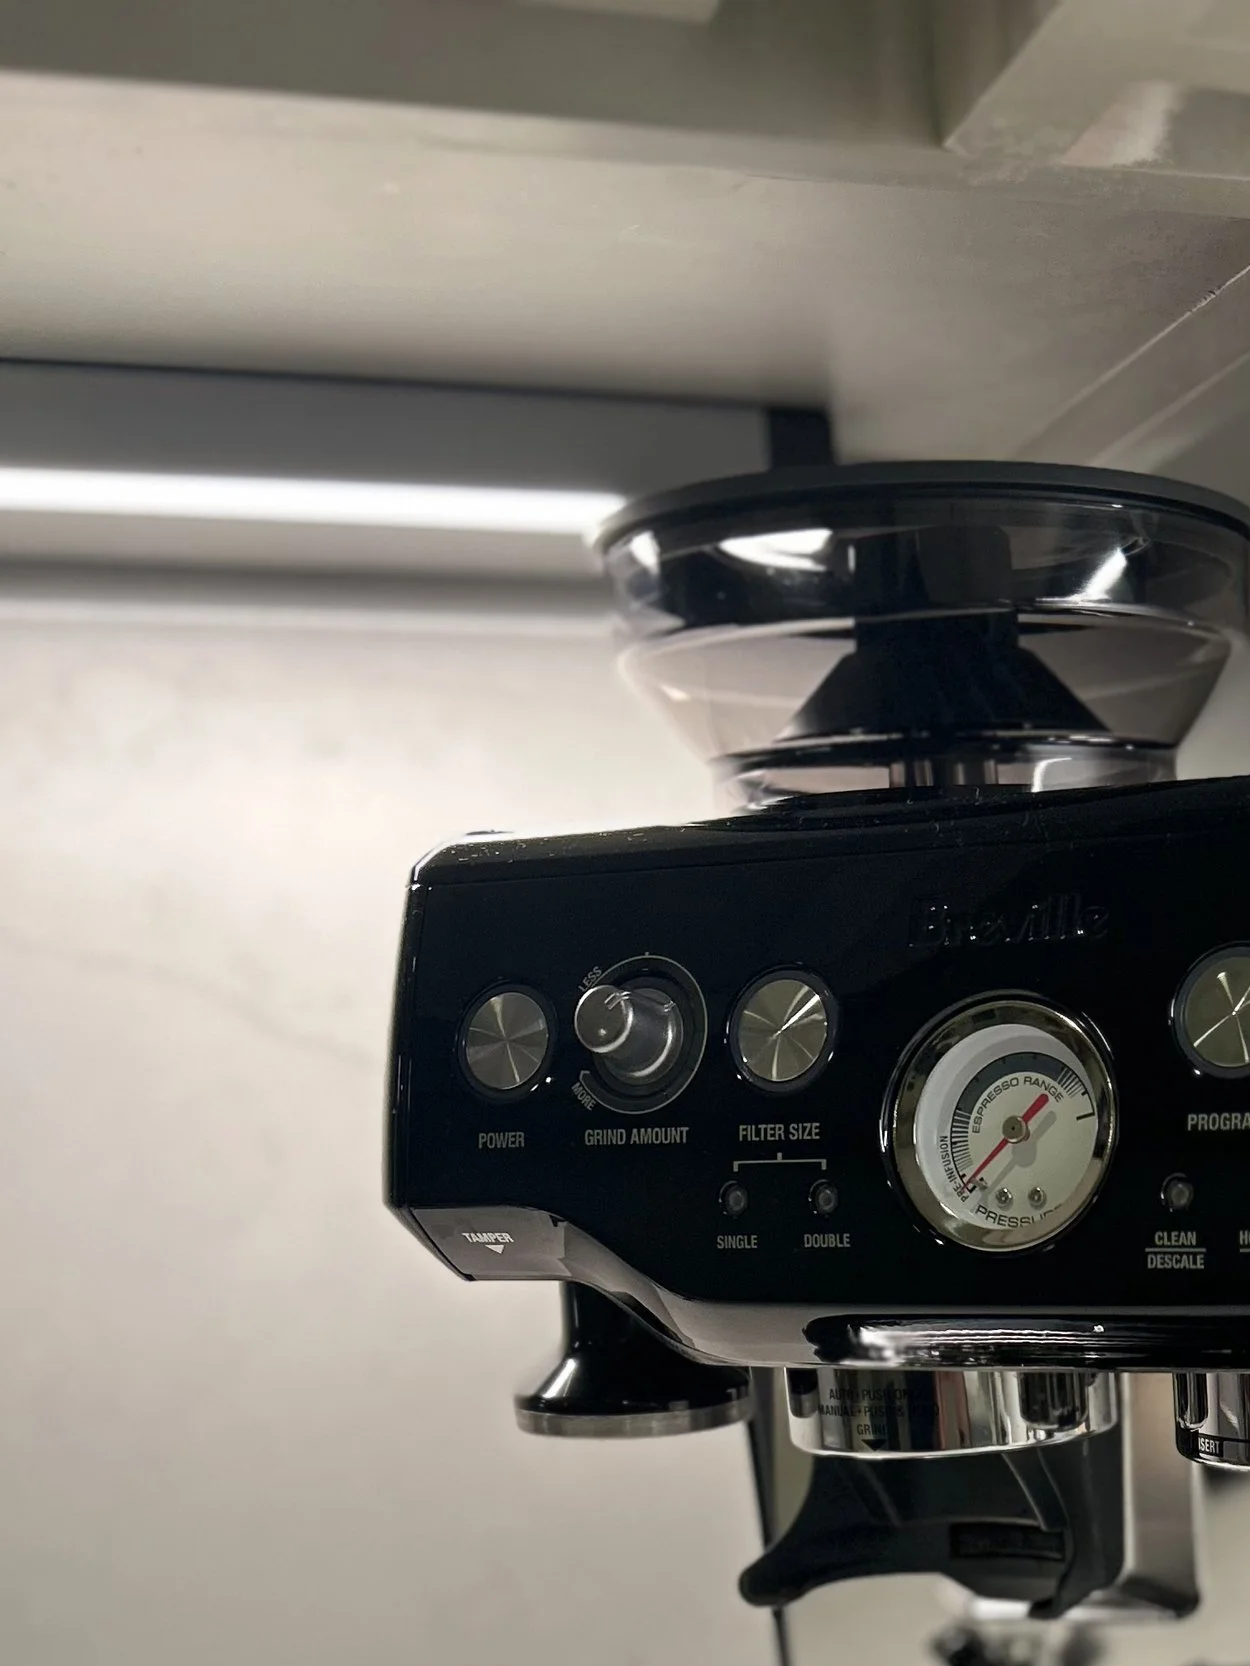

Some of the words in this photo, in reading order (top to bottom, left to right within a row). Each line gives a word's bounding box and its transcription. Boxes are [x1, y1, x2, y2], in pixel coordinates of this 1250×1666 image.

[578, 966, 602, 992] LESS
[571, 1082, 596, 1111] MORE
[972, 1077, 1019, 1133] ESPRESSO
[1023, 1076, 1064, 1103] RANGE
[478, 1131, 525, 1149] POWER
[584, 1129, 626, 1146] GRIND
[630, 1126, 690, 1145] AMOUNT
[739, 1124, 785, 1141] FILTER
[789, 1123, 820, 1140] SIZE
[939, 1135, 969, 1203] PRE-INFUSION
[975, 1204, 1063, 1229] PRESS
[462, 1232, 514, 1243] TAMPER
[717, 1235, 758, 1249] SINGLE
[804, 1233, 851, 1248] DOUBLE
[1154, 1231, 1197, 1246] CLEAN
[1147, 1254, 1205, 1269] DESCALE
[829, 1388, 855, 1401] AUTO
